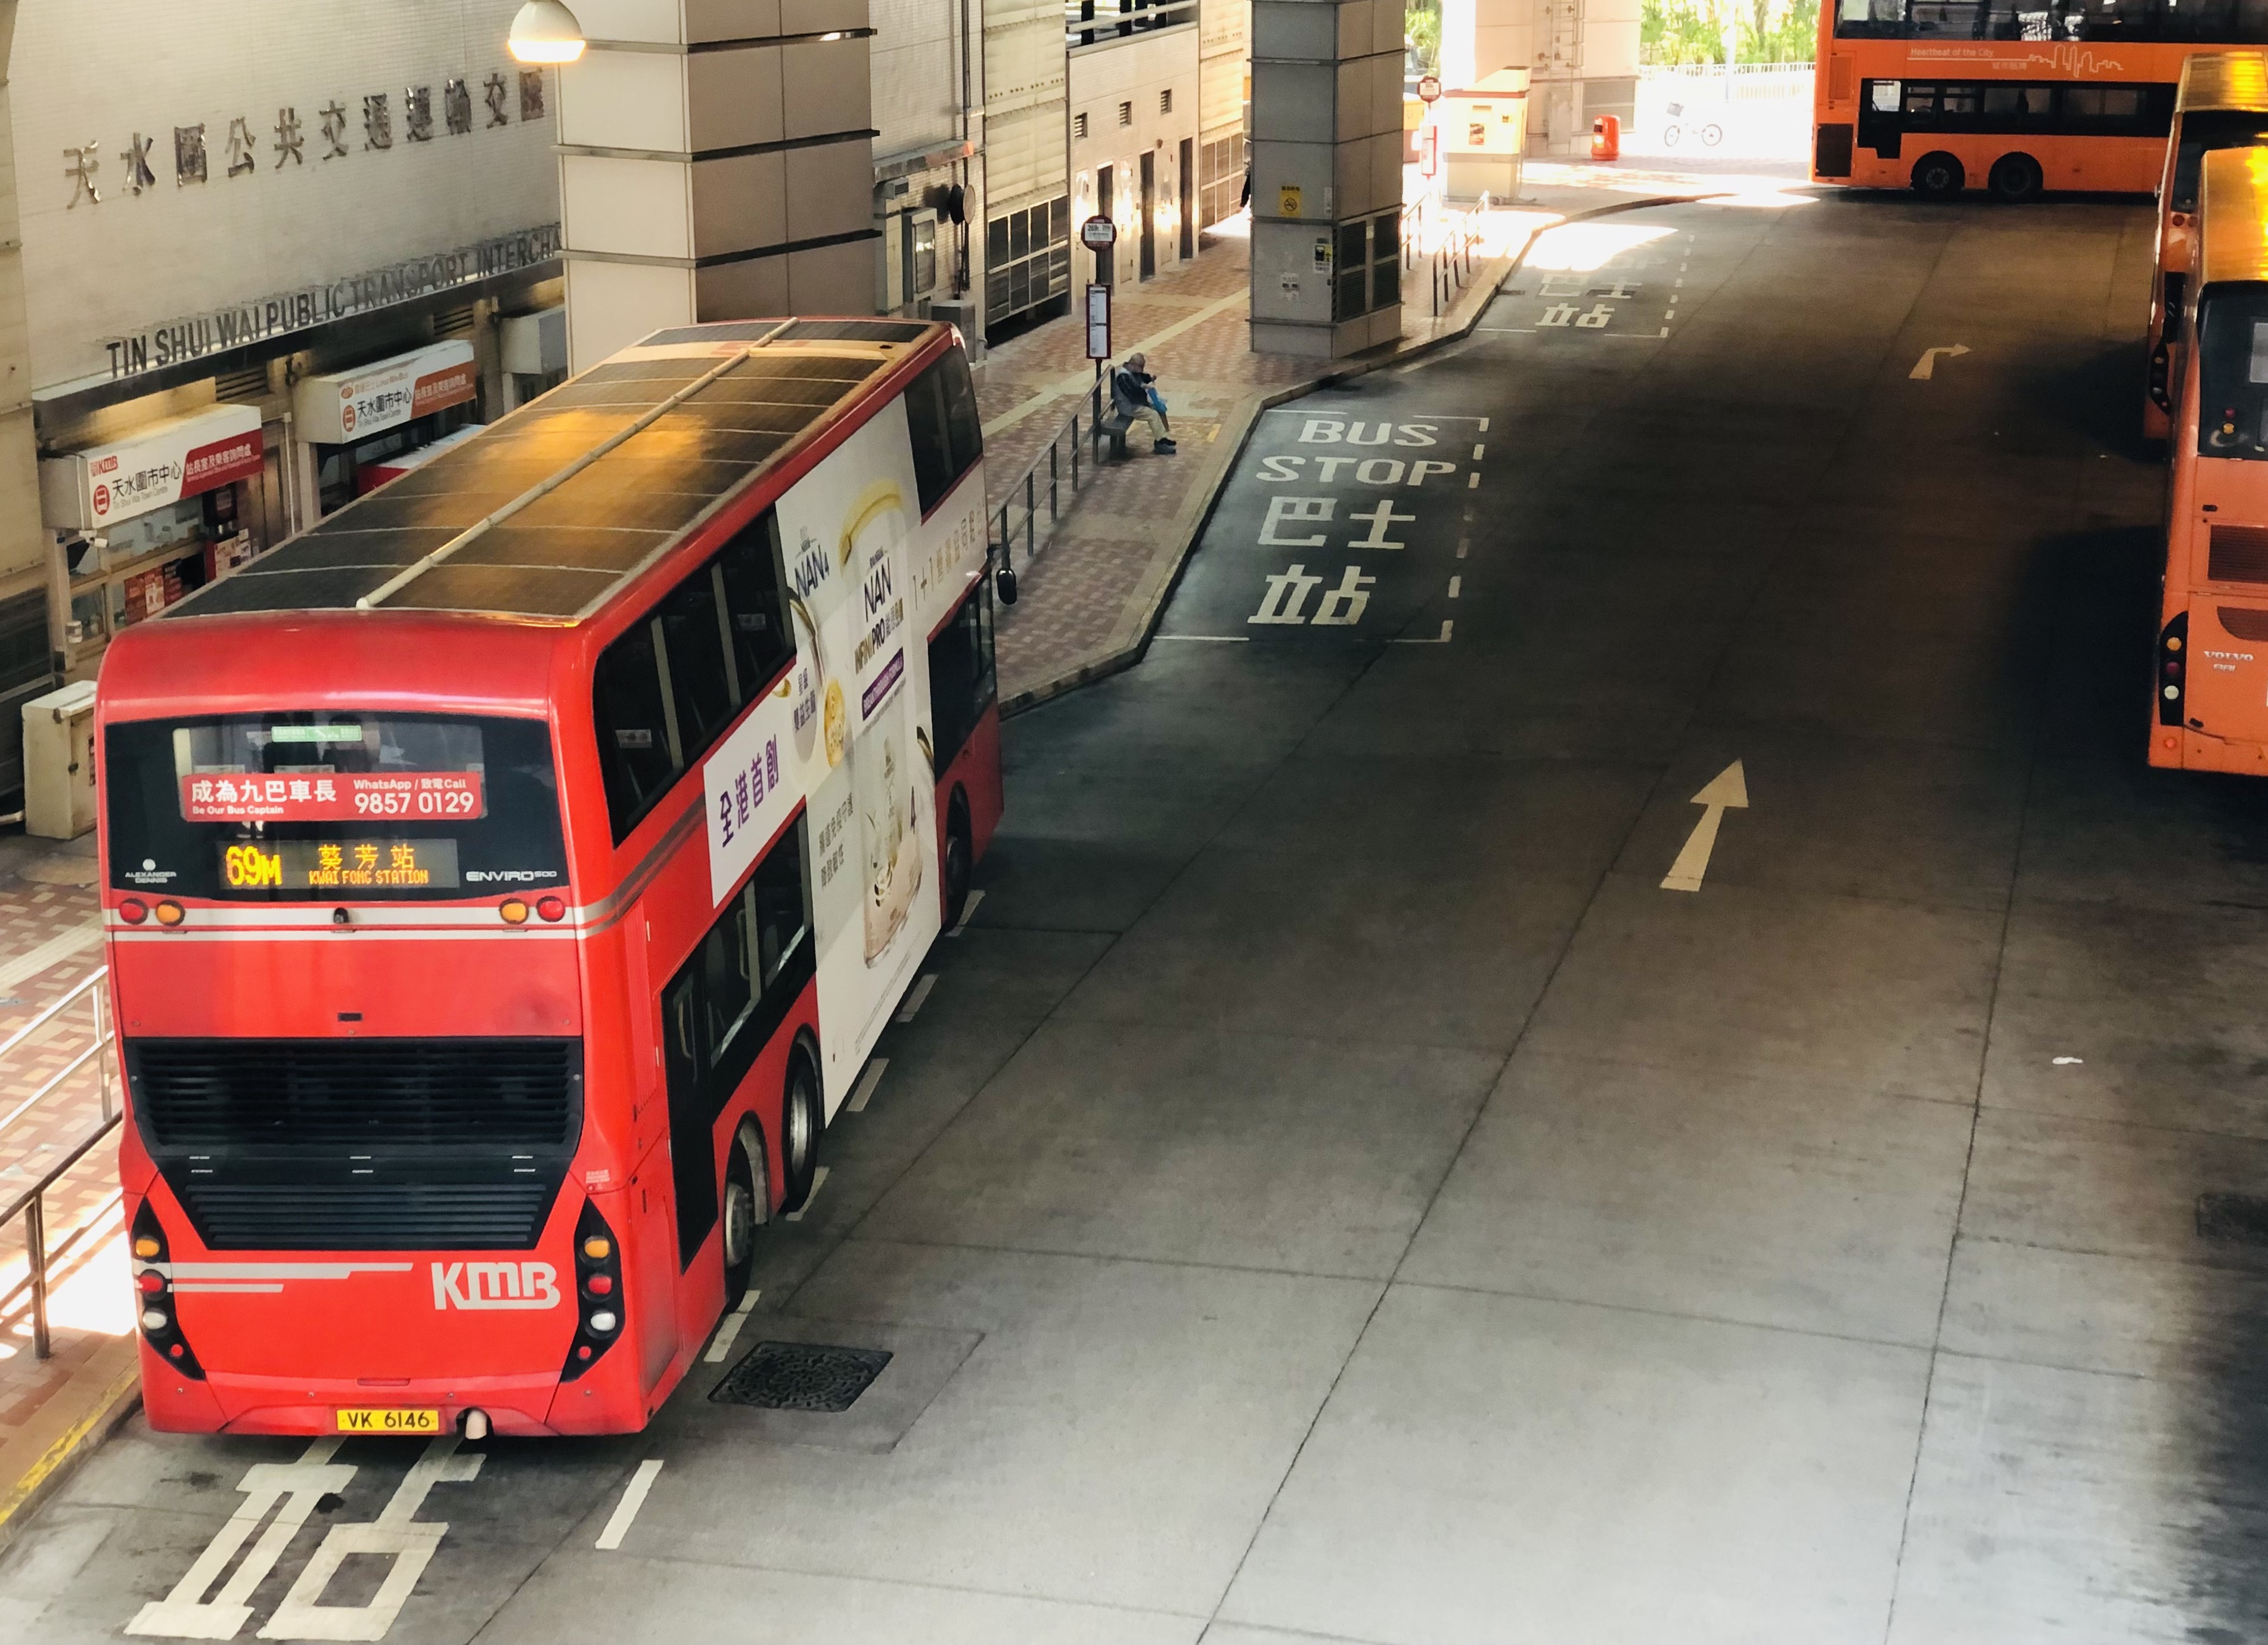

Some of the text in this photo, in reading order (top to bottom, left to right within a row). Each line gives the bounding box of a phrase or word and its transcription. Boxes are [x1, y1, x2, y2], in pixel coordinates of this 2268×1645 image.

[1910, 48, 1994, 57] Heartbeat of the City
[1538, 273, 1642, 299] 巴士
[106, 335, 147, 379] TIN
[155, 318, 212, 366] SHUI
[216, 305, 260, 348] WAI
[266, 284, 345, 336] PUBLIC
[349, 252, 468, 310] TRANSPORT
[1535, 302, 1615, 328] 站
[358, 386, 412, 419] 天水圍市中心
[1298, 419, 1438, 447] BUS
[98, 456, 118, 475] KMB
[1255, 456, 1457, 486] STOP
[112, 460, 182, 500] 天水圍市中心
[1257, 497, 1416, 549] 巴士
[864, 557, 891, 622] NAN
[1248, 564, 1376, 625] 站
[2203, 650, 2254, 661] VOLVO
[191, 779, 337, 803] 成為九巴車長
[353, 779, 411, 791] WhatsApp
[720, 733, 778, 848] 全港首創
[192, 806, 284, 816] Be Our Bus Captain
[355, 792, 474, 814] 9857 0129
[227, 845, 283, 885] 69M
[318, 843, 415, 870] 葵芳站
[309, 870, 429, 885] KWAI FONG STATION
[431, 1262, 561, 1310] KMB
[347, 1411, 430, 1428] VK 6146
